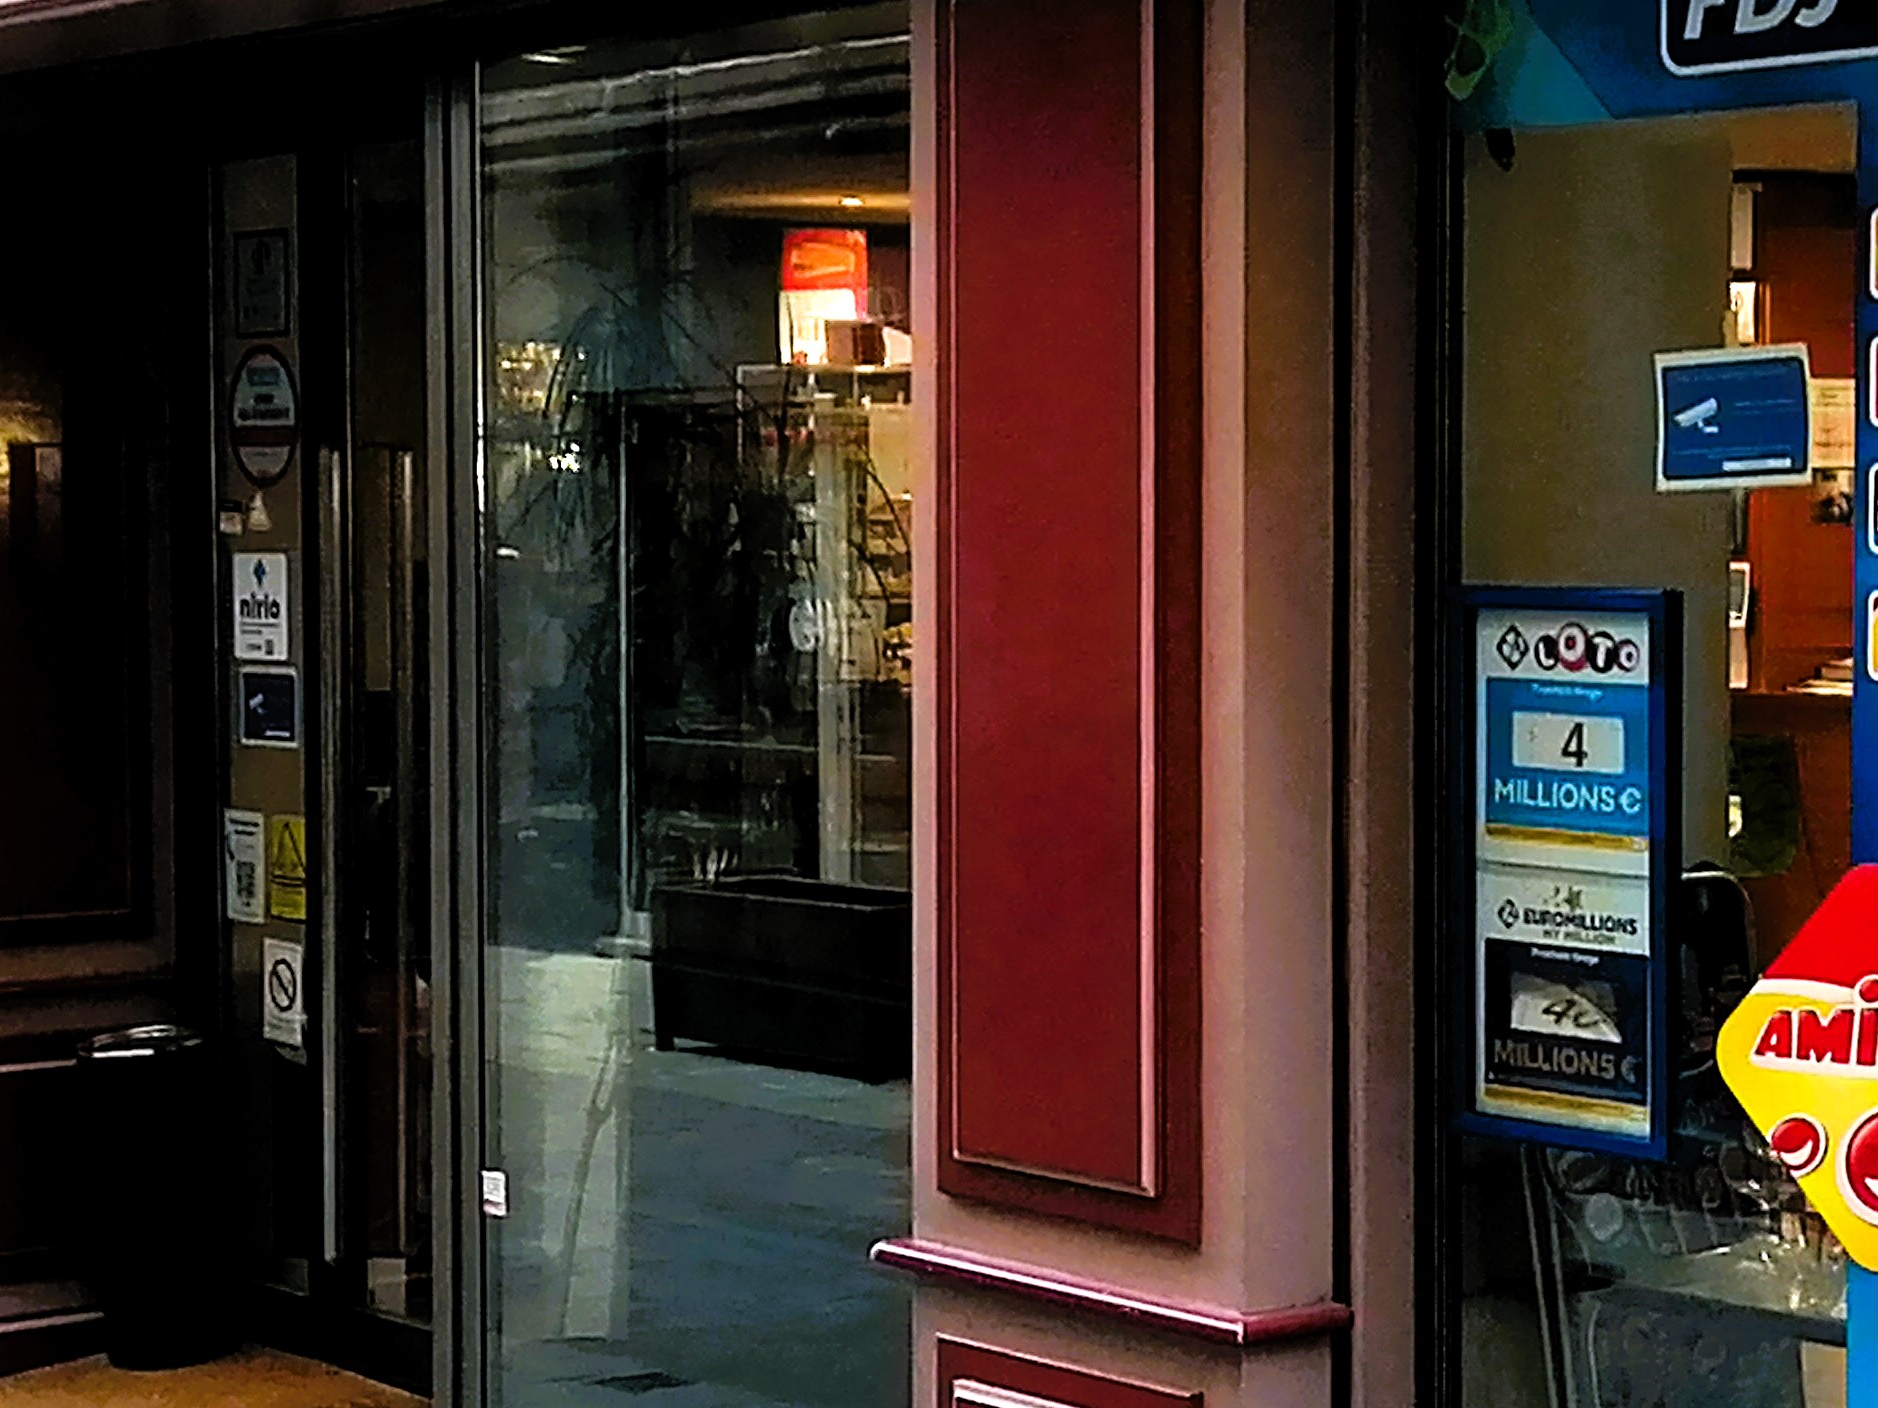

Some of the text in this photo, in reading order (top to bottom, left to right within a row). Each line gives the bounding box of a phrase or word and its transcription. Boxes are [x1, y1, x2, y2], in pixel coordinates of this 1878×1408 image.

[1534, 622, 1641, 673] LOTO
[1561, 723, 1588, 768] 4
[1494, 778, 1615, 812] MILLIONS
[1523, 908, 1638, 935] EUROMILLIONS
[1494, 1038, 1616, 1080] MILLIONS
